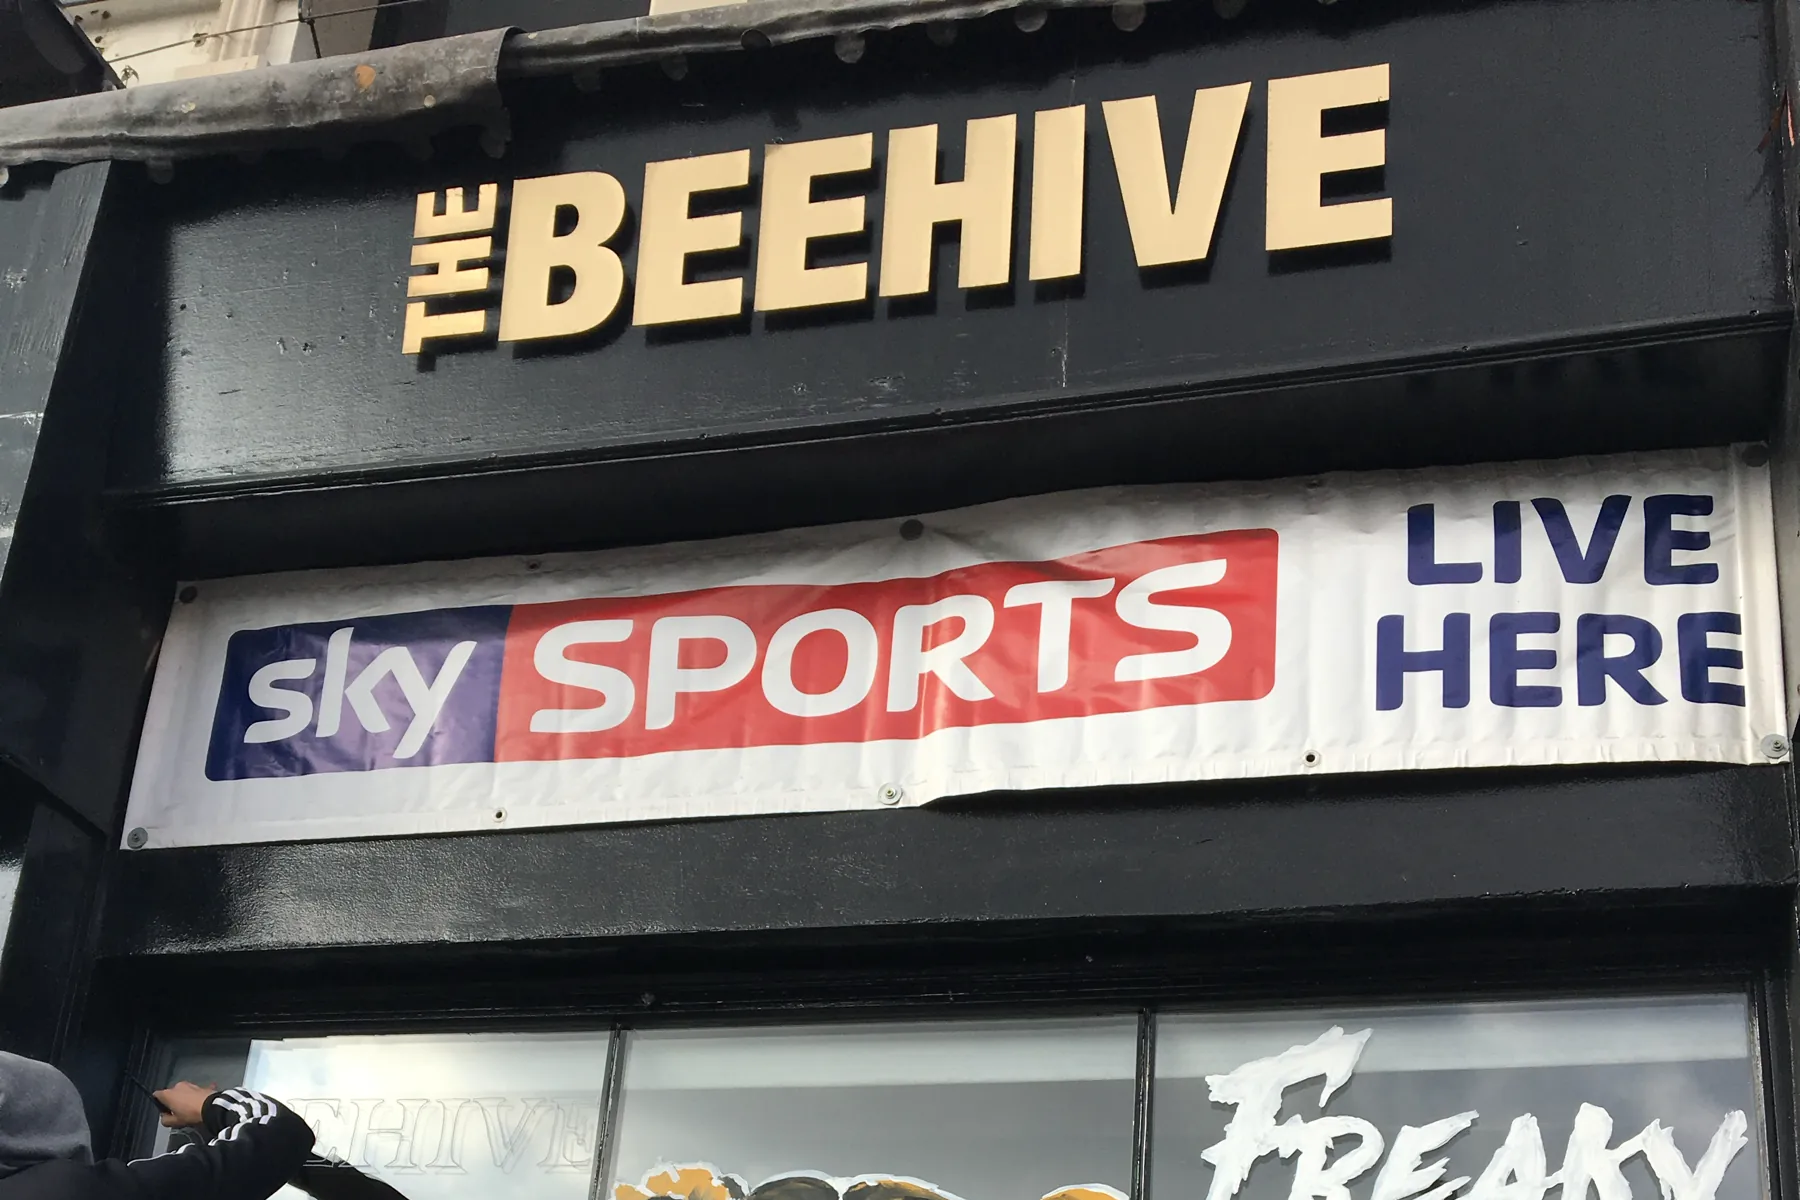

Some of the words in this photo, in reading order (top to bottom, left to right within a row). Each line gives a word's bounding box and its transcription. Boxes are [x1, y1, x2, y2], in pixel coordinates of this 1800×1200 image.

[402, 183, 498, 354] THE
[498, 64, 1392, 343] BEEHIVE
[1407, 494, 1720, 586] LIVE
[243, 627, 477, 759] sky
[530, 559, 1231, 733] SPORTS
[1376, 612, 1745, 711] HERE
